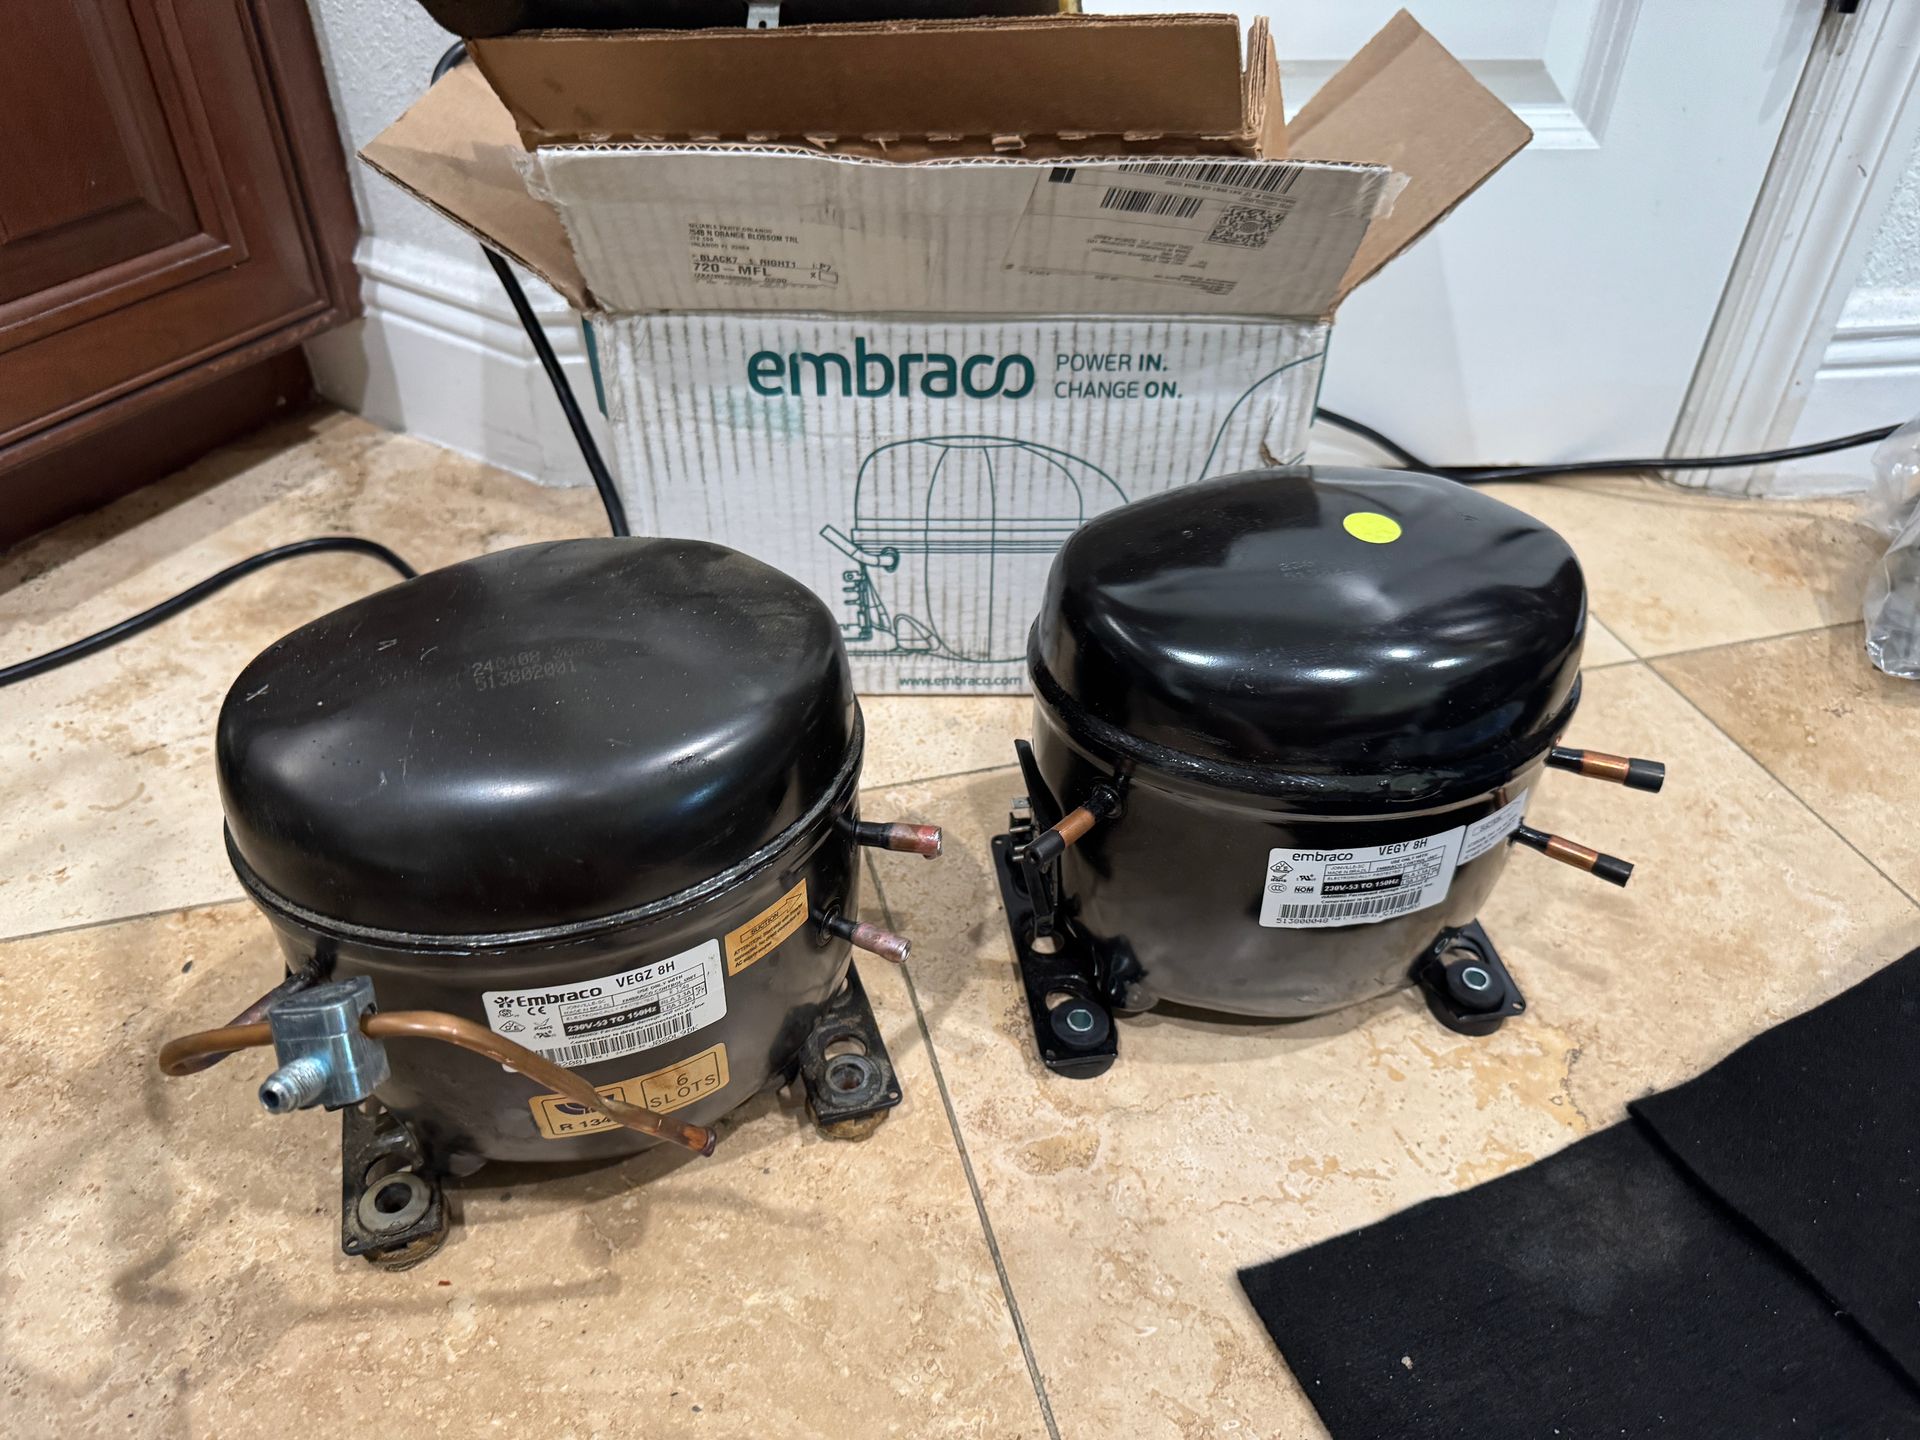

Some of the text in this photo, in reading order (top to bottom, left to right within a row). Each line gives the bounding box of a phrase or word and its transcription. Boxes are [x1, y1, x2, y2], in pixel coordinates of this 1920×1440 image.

[714, 231, 744, 240] ORANGE
[747, 233, 783, 242] BLOSSOM
[785, 236, 799, 244] TRL
[700, 254, 738, 264] BLACK7
[693, 262, 720, 273] 720
[738, 265, 772, 277] MFL
[747, 337, 1035, 399] embraco
[1056, 353, 1168, 372] POWER IN.
[1054, 380, 1183, 399] CHANGE ON.
[899, 676, 1022, 686] www.embraco.com
[1292, 838, 1428, 862] embraco VEGY 8H
[1324, 882, 1358, 892] 230V-53
[517, 960, 675, 1008] Embraco VEGZ 8H
[608, 1014, 625, 1024] TO
[677, 1073, 689, 1086] 6
[650, 1073, 716, 1108] SLOTS
[559, 1114, 614, 1132] R 134
